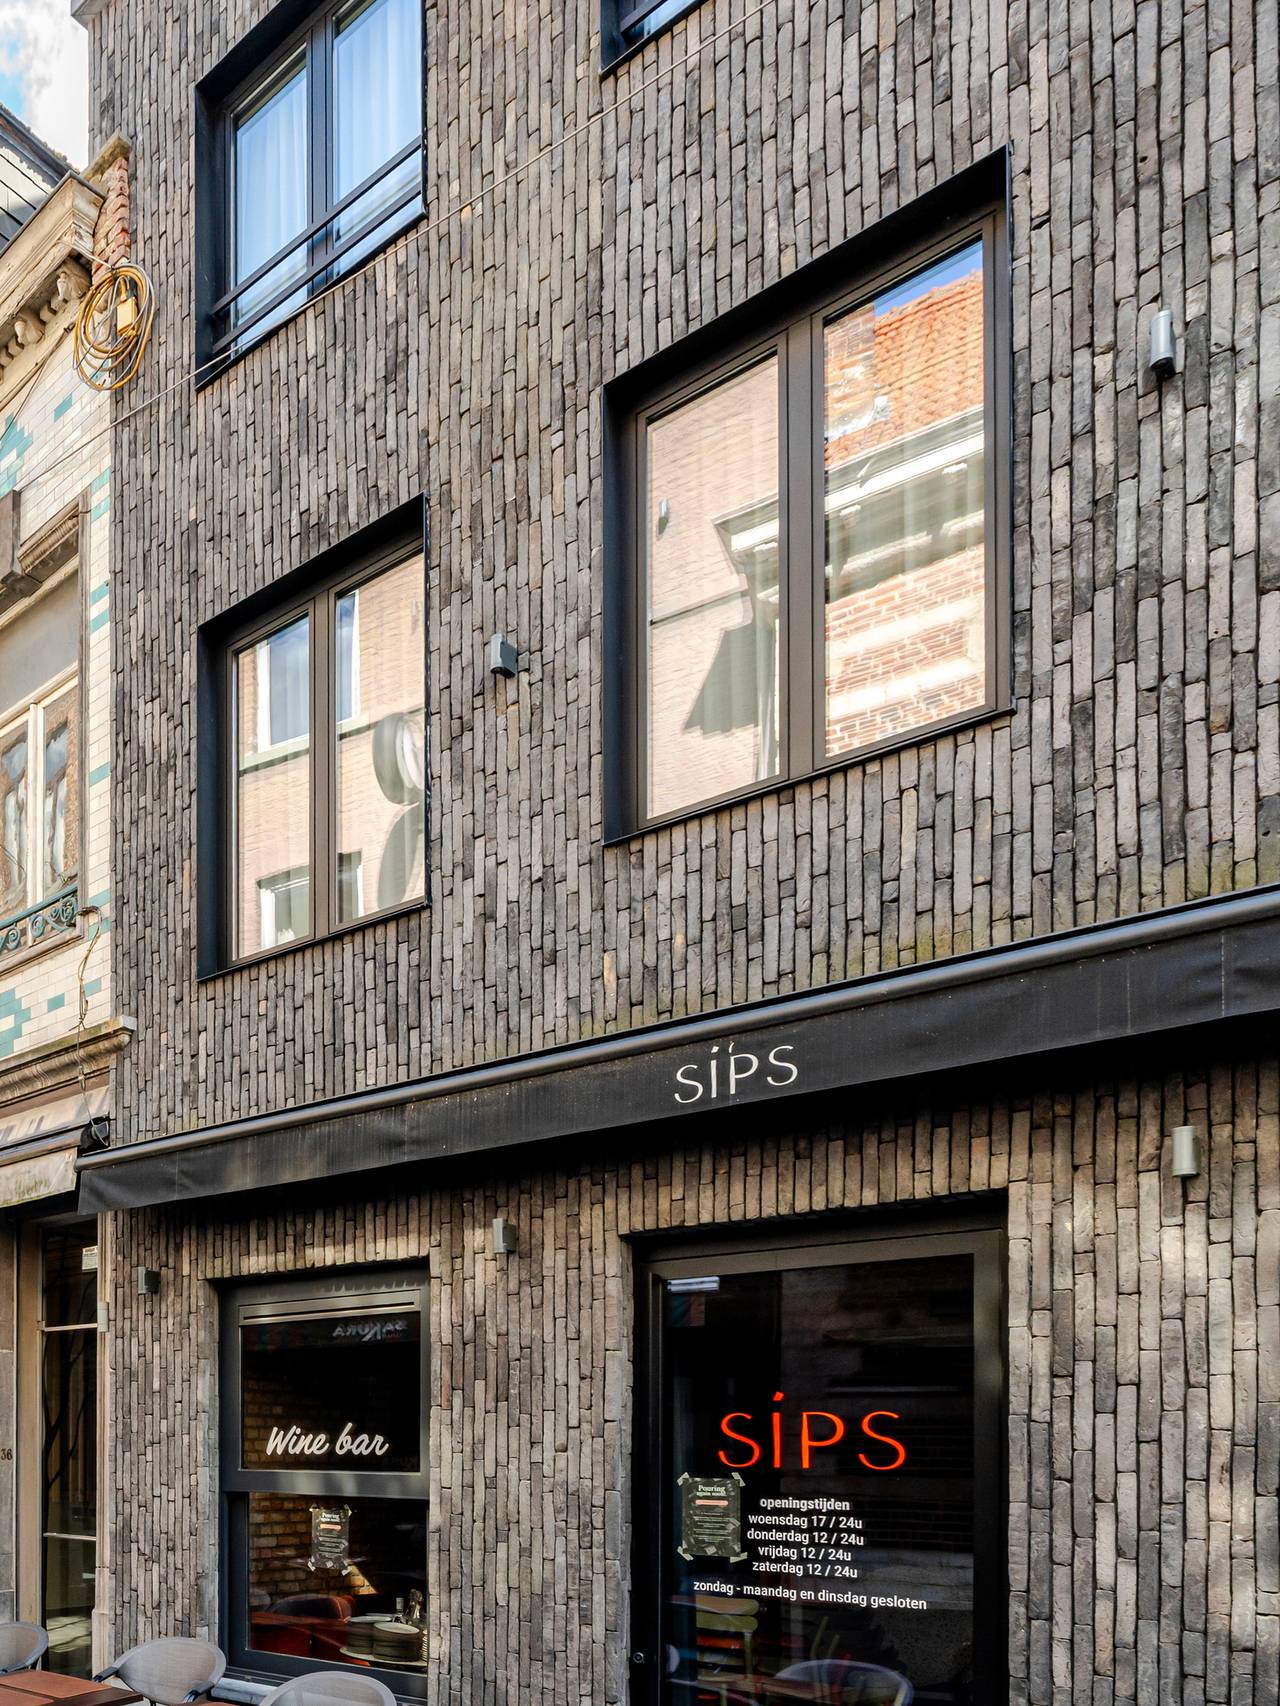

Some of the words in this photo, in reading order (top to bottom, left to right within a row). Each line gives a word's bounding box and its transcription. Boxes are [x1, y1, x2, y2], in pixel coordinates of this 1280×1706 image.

[265, 1425, 329, 1456] Wine
[335, 1422, 389, 1456] bar
[759, 1498, 851, 1512] openingstijden
[748, 1514, 808, 1528] woensdag
[811, 1516, 825, 1527] 17
[839, 1517, 863, 1529] 24u
[747, 1528, 810, 1544] donderdag
[812, 1531, 828, 1543] 12
[840, 1533, 864, 1546] 24u
[758, 1545, 798, 1560] vrijdag
[801, 1548, 815, 1558] 12
[828, 1549, 852, 1561] 24u
[752, 1560, 803, 1576] zaterdag
[806, 1563, 821, 1575] 12
[834, 1565, 858, 1578] 24u
[693, 1580, 734, 1595] zondag
[743, 1585, 797, 1601] maandag
[800, 1590, 815, 1600] en
[818, 1589, 867, 1606] dinsdag
[871, 1594, 927, 1610] gesloten
